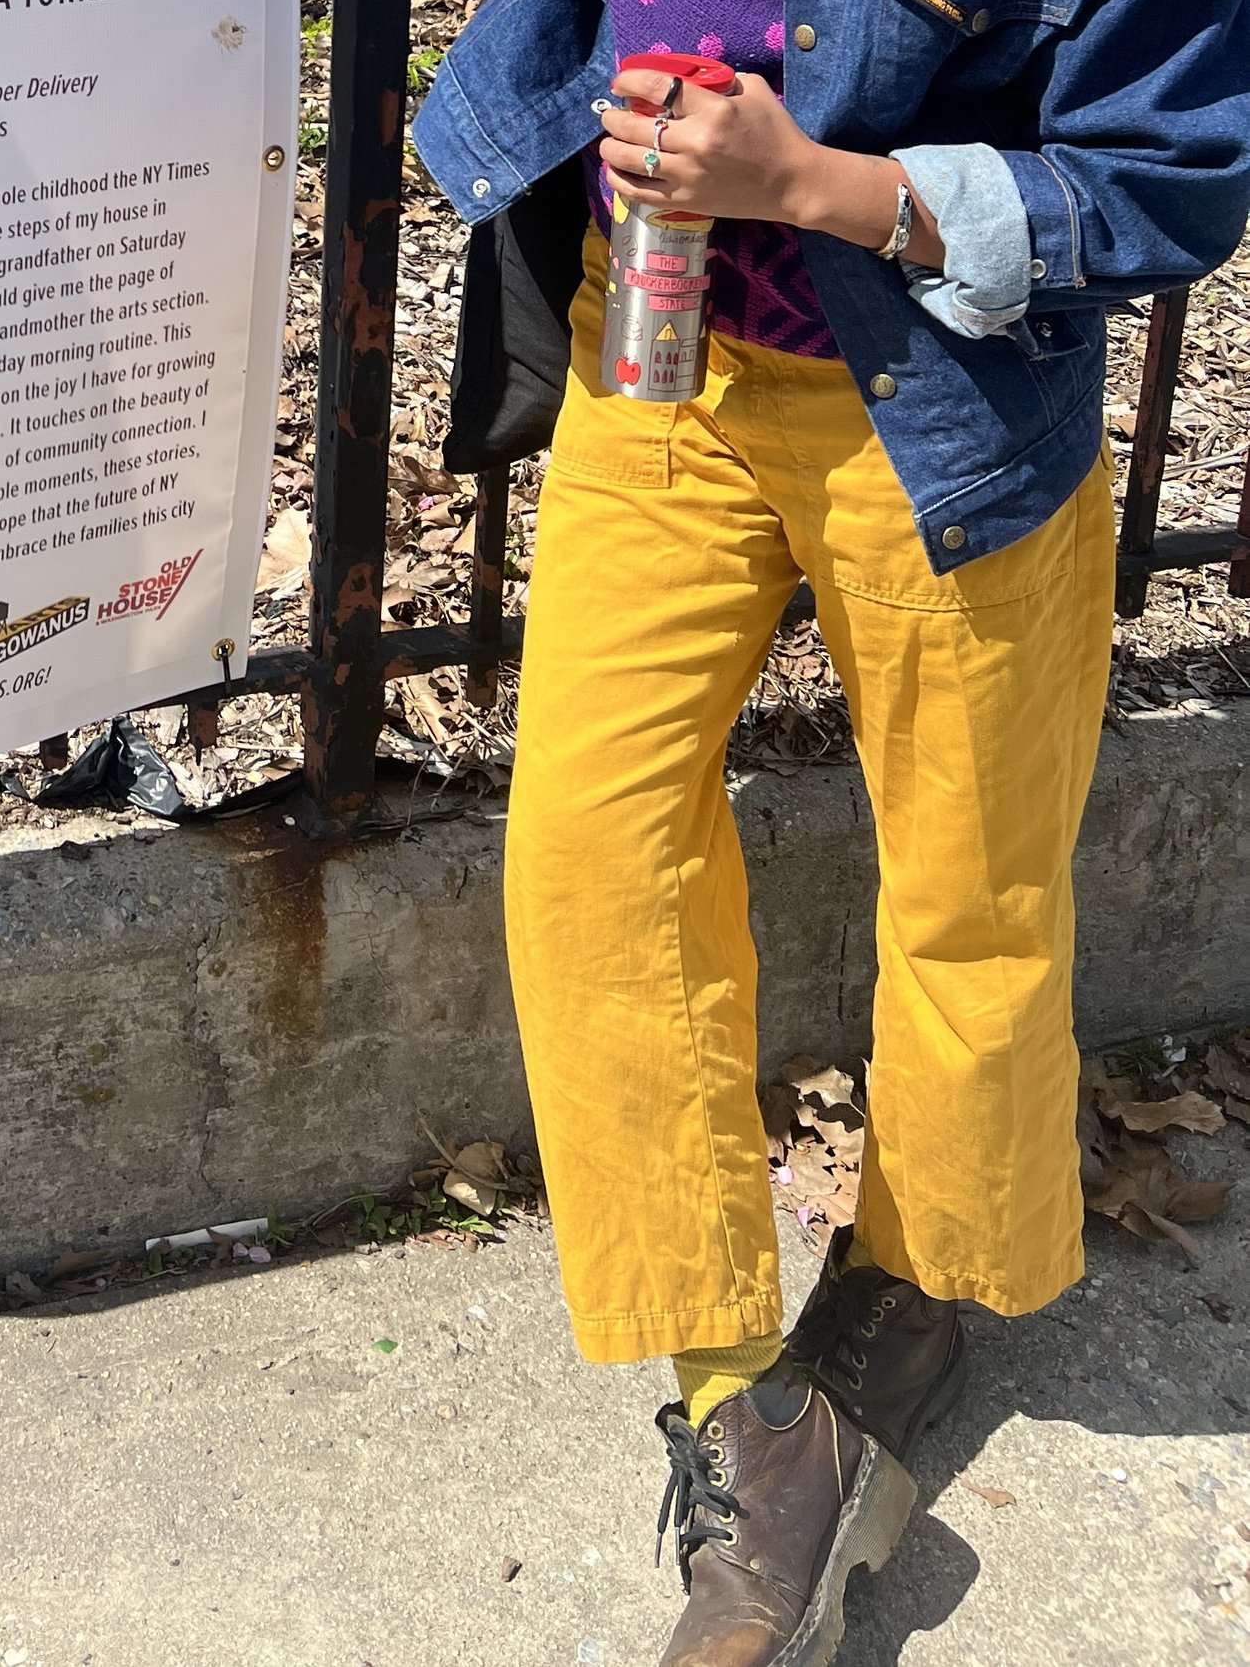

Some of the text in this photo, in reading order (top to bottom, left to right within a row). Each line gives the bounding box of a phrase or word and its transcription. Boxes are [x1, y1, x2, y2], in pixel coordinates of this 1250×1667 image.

[27, 74, 98, 98] Delivery
[32, 173, 108, 201] childhood
[113, 170, 137, 189] the
[143, 164, 162, 185] NY
[167, 162, 209, 181] Times
[8, 219, 50, 240] steps
[55, 211, 71, 231] of
[76, 212, 98, 231] my
[103, 205, 148, 224] house
[153, 198, 166, 216] in
[97, 243, 114, 258] on
[120, 230, 186, 254] Saturday
[659, 256, 679, 270] THE
[23, 283, 55, 308] give
[61, 281, 84, 297] me
[90, 274, 113, 292] the
[118, 269, 155, 292] page
[160, 261, 174, 280] of
[658, 298, 686, 310] STATE
[90, 306, 114, 325] the
[119, 300, 147, 319] arts
[152, 291, 208, 313] section.
[31, 342, 94, 367] morning
[100, 332, 157, 355] routine.
[163, 322, 191, 342] This
[1, 389, 19, 405] on
[26, 382, 49, 400] the
[54, 378, 77, 400] joy
[82, 372, 86, 390] I
[91, 369, 126, 388] have
[132, 362, 152, 379] for
[157, 351, 215, 379] growing
[11, 418, 20, 435] It
[27, 408, 85, 432] touches
[90, 403, 107, 419] on
[113, 396, 135, 414] the
[141, 386, 191, 408] beauty
[195, 379, 209, 397] of
[5, 448, 20, 467] of
[25, 433, 107, 463] community
[112, 416, 195, 444] connection.
[202, 410, 206, 426] I
[25, 467, 98, 495] moments,
[104, 456, 141, 477] these
[146, 444, 199, 466] stories,
[32, 503, 61, 524] that
[67, 498, 90, 515] the
[95, 487, 137, 509] future
[142, 478, 155, 497] of
[160, 472, 178, 492] NY
[53, 531, 75, 548] the
[81, 517, 138, 542] families
[143, 507, 167, 527] this
[171, 500, 195, 518] city
[119, 569, 183, 599] STONE
[160, 556, 192, 574] OLD
[97, 586, 173, 620] HOUSE
